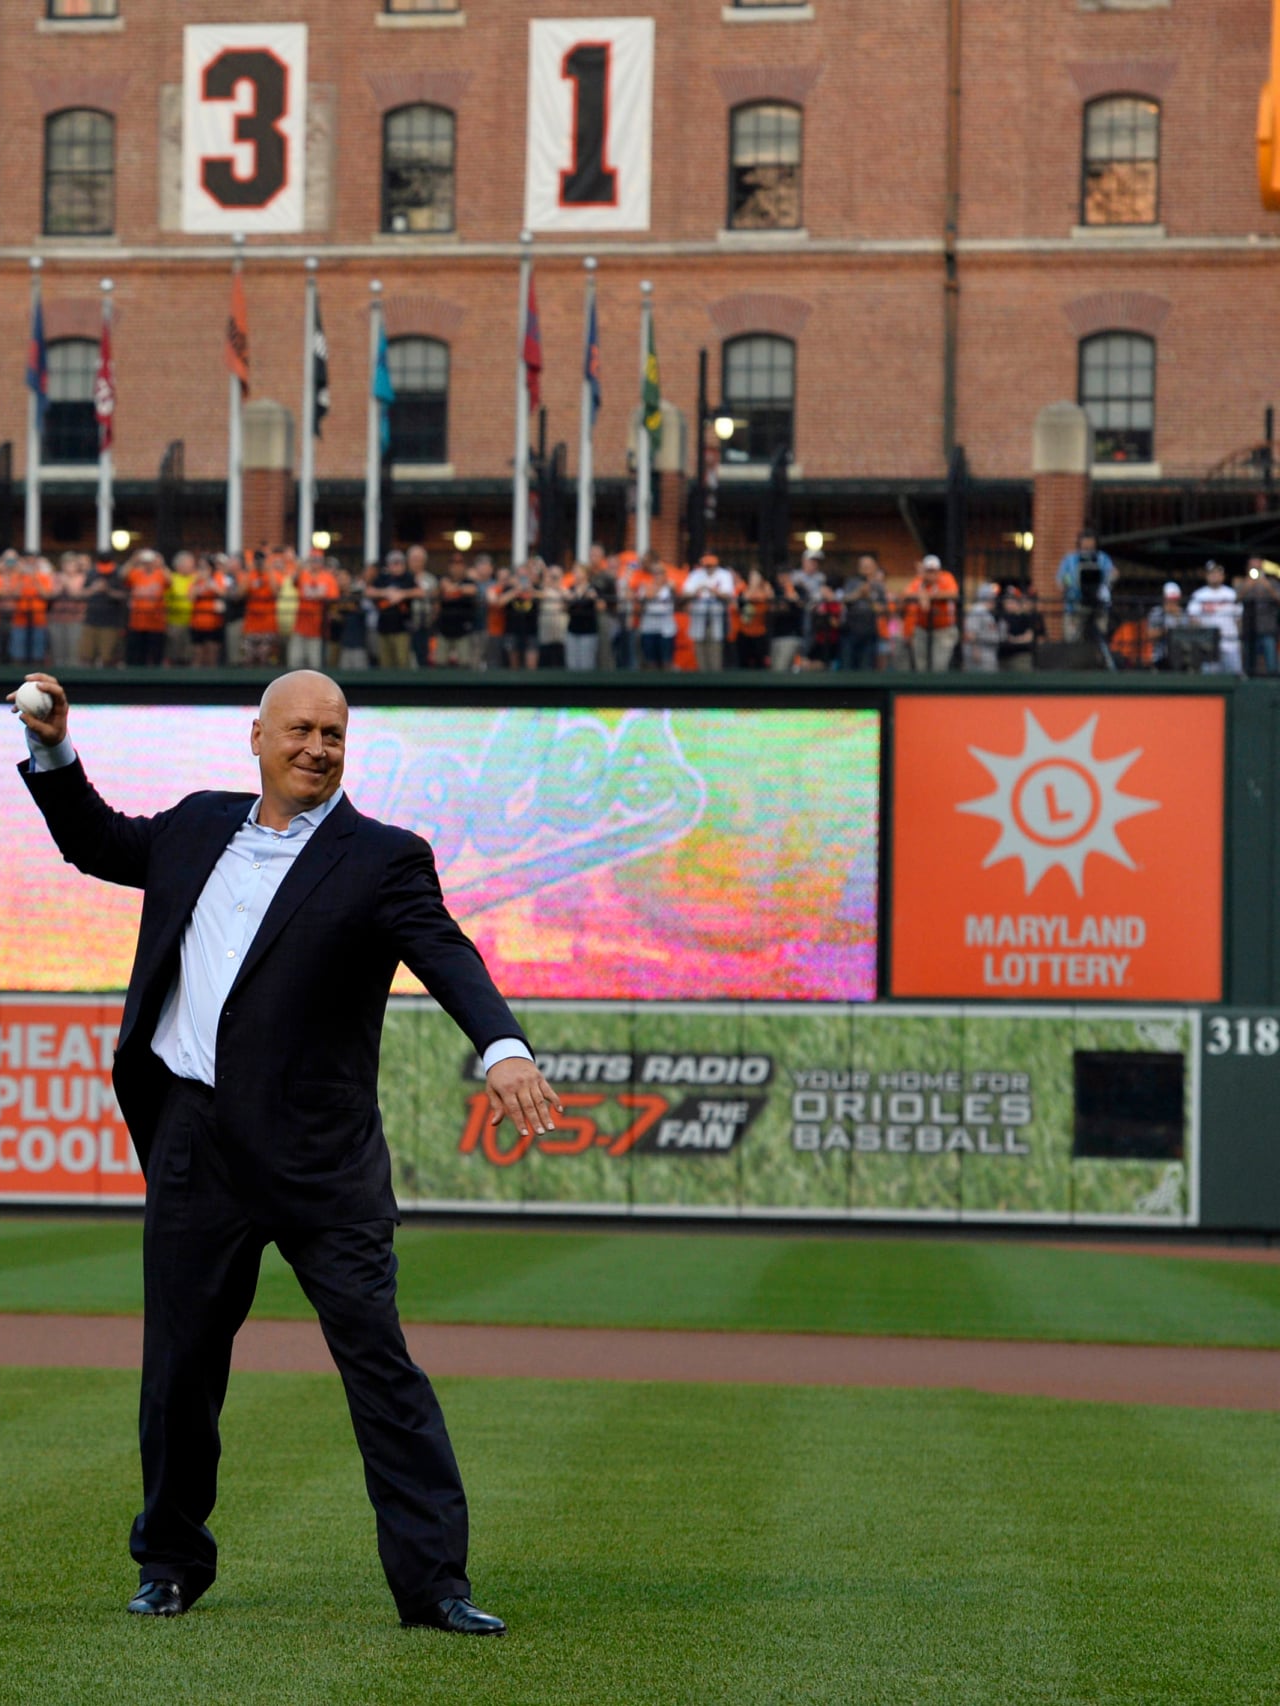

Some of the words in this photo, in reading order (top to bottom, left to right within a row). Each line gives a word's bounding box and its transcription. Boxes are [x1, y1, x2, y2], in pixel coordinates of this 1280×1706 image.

[198, 45, 290, 211] 3
[555, 40, 620, 208] 1
[964, 914, 1146, 949] MARYLAND
[982, 954, 1130, 987] LOTTERY
[1206, 1016, 1280, 1056] 318
[473, 1054, 632, 1084] ORTS
[641, 1056, 771, 1084] RADIO
[793, 1071, 870, 1090] YOUR
[878, 1072, 962, 1091] HOME
[972, 1073, 1030, 1092] FOR
[696, 1101, 751, 1123] THE
[792, 1091, 1032, 1125] ORIOLES
[656, 1121, 738, 1149] FAN
[793, 1124, 1030, 1154] BASEBALL
